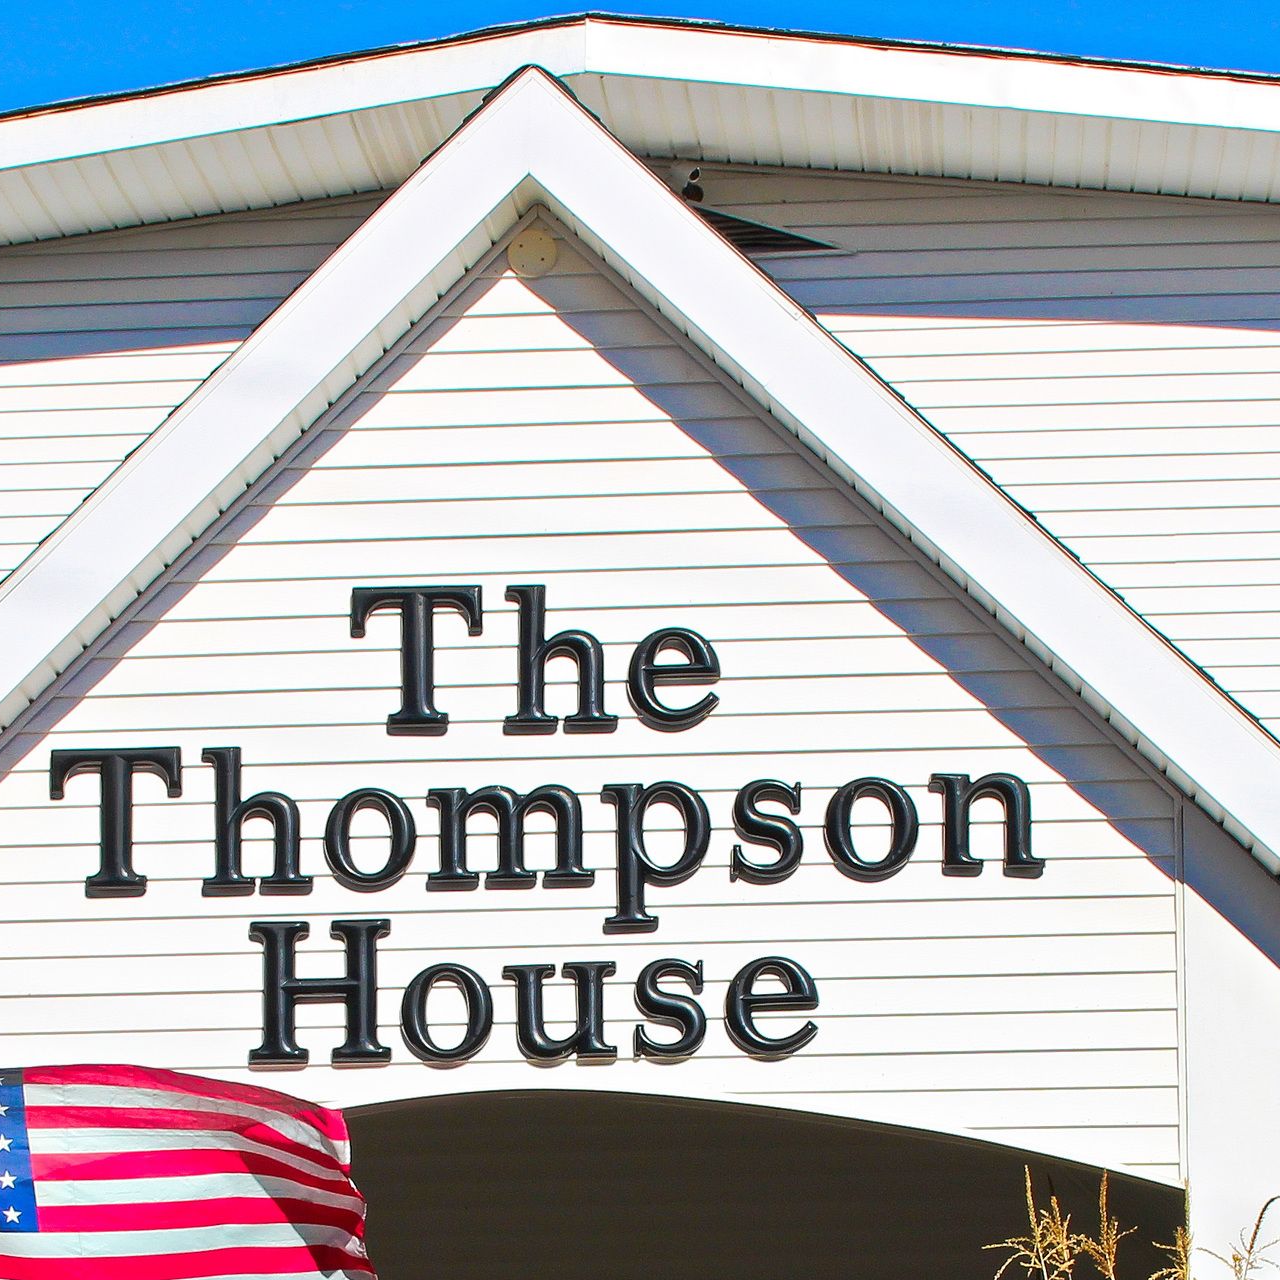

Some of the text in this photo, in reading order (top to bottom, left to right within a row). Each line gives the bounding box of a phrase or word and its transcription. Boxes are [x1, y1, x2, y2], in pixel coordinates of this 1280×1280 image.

[349, 584, 722, 736] The
[49, 746, 1047, 934] Thompson
[248, 919, 819, 1067] House
